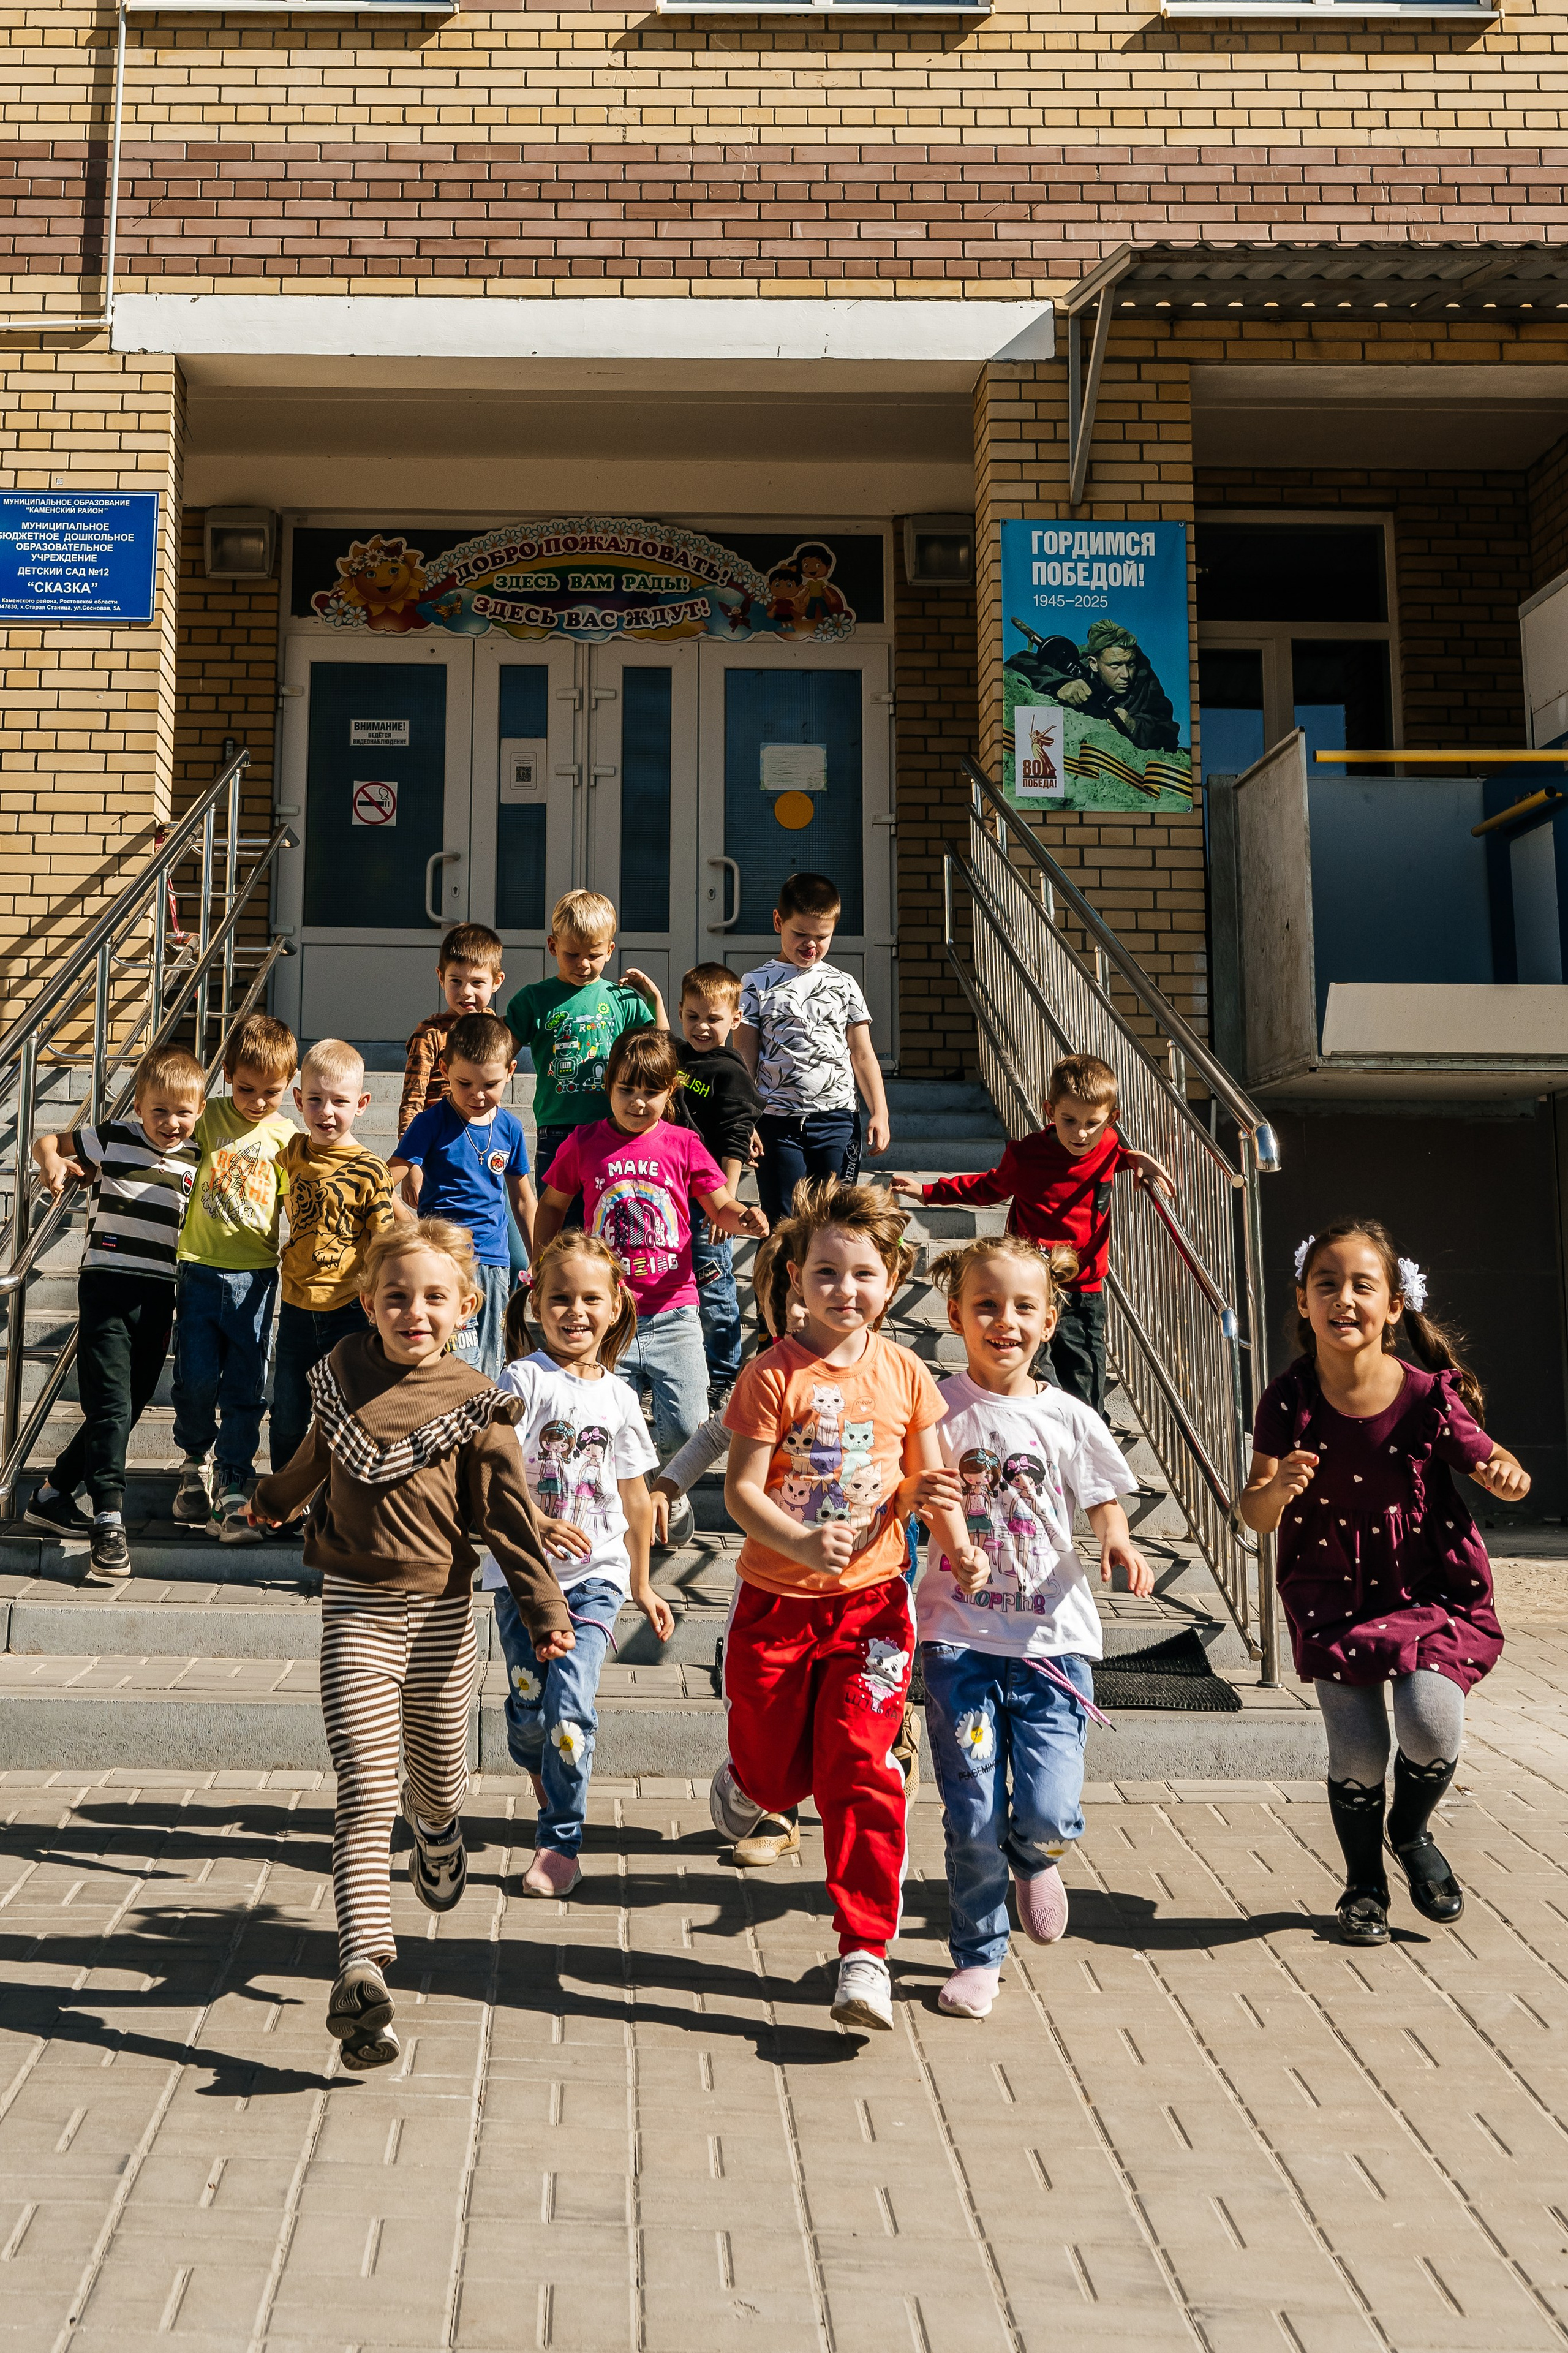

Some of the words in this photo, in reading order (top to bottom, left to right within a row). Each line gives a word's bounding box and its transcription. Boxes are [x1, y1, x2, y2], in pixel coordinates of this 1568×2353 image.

[21, 522, 109, 531] МУНИЦИПАЛЬНОЕ
[64, 533, 134, 542] ДОШКОЛЬНОЕ
[16, 543, 113, 551] ОБРАЗОВАТЕЛЬНОЕ
[1031, 531, 1156, 559] ГОРДИМСЯ
[31, 553, 97, 562] УЧРЕЖДЕНИЕ
[455, 540, 538, 583] ДОБРО
[543, 534, 733, 586] ПОЖАЛОВАТЬ!
[18, 566, 62, 576] ДЕТСКИЙ
[65, 568, 86, 577] САД
[1032, 560, 1145, 591] ПОБЕДОЙ!
[495, 573, 559, 592] ЗДЕСЬ
[569, 573, 614, 590] ВАМ
[624, 574, 690, 592] РАДЫ!
[475, 595, 556, 627] ЗДЕСЬ
[565, 611, 617, 629] ВАС
[625, 598, 710, 627] ЖДУТ!
[354, 722, 406, 731] ВНИМАНИЕ!
[1022, 759, 1041, 776] 80
[1022, 779, 1057, 789] ПОБЕДА!
[608, 1160, 659, 1177] MAKE
